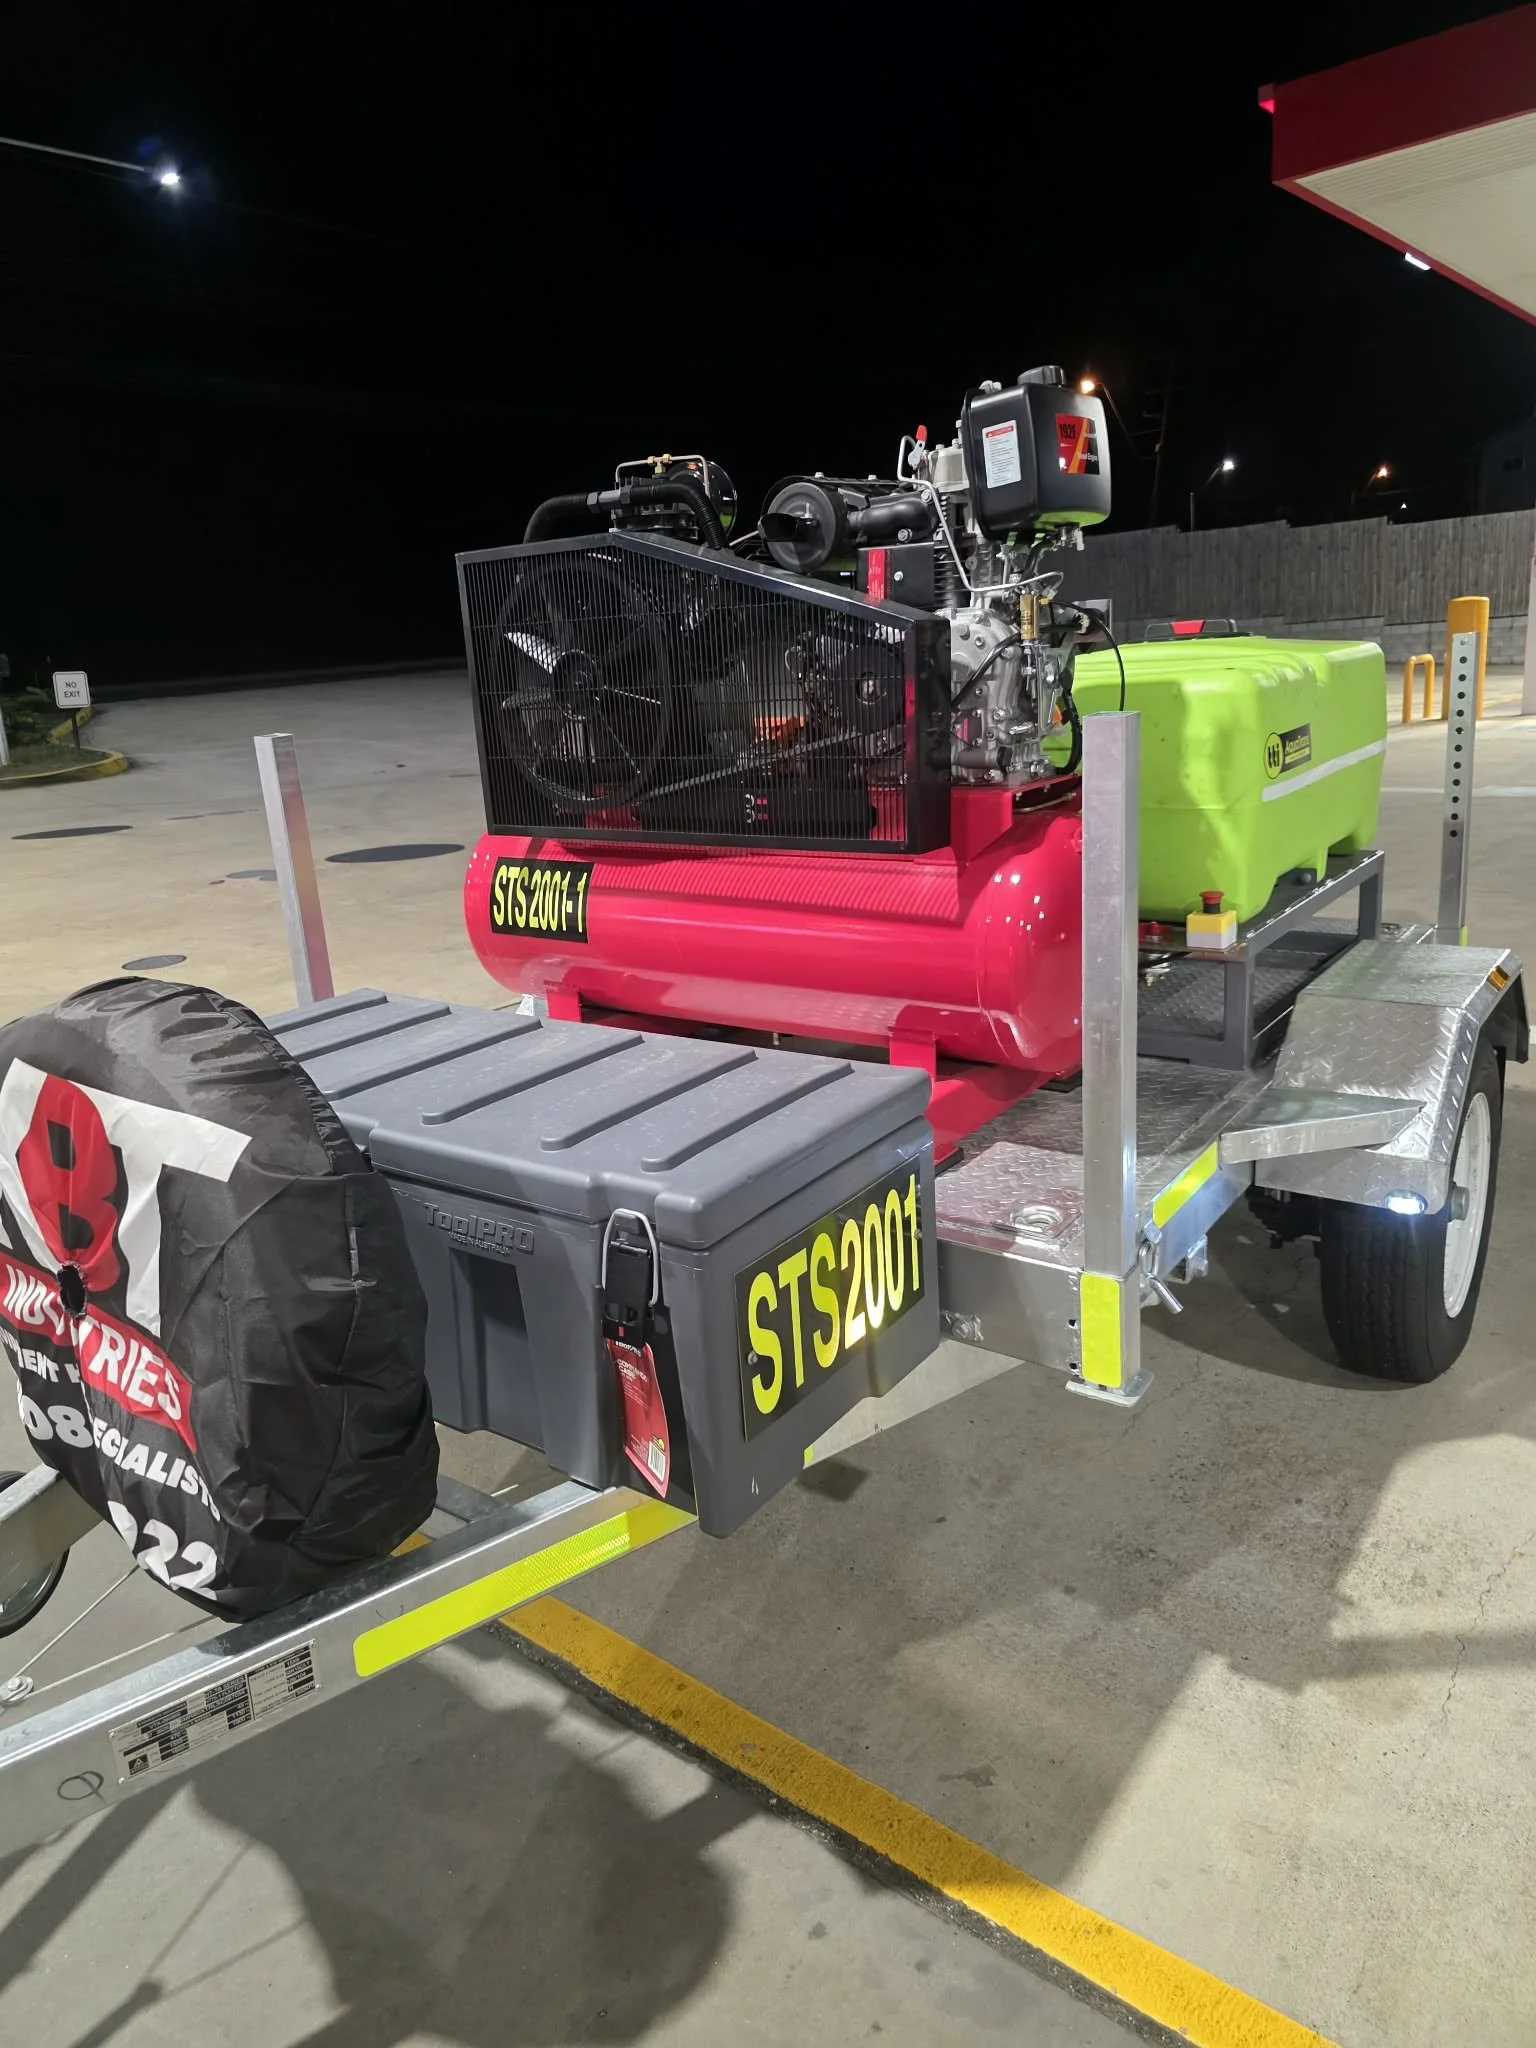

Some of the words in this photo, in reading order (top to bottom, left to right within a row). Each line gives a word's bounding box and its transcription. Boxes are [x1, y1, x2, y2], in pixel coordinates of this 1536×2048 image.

[424, 1202, 535, 1255] ToolPRO
[448, 1231, 466, 1244] MADE
[475, 1238, 511, 1257] AUSTRALIA
[3, 1264, 183, 1420] INDUTRIES
[747, 1173, 921, 1415] STS2001
[93, 1418, 221, 1522] ECIALISTS
